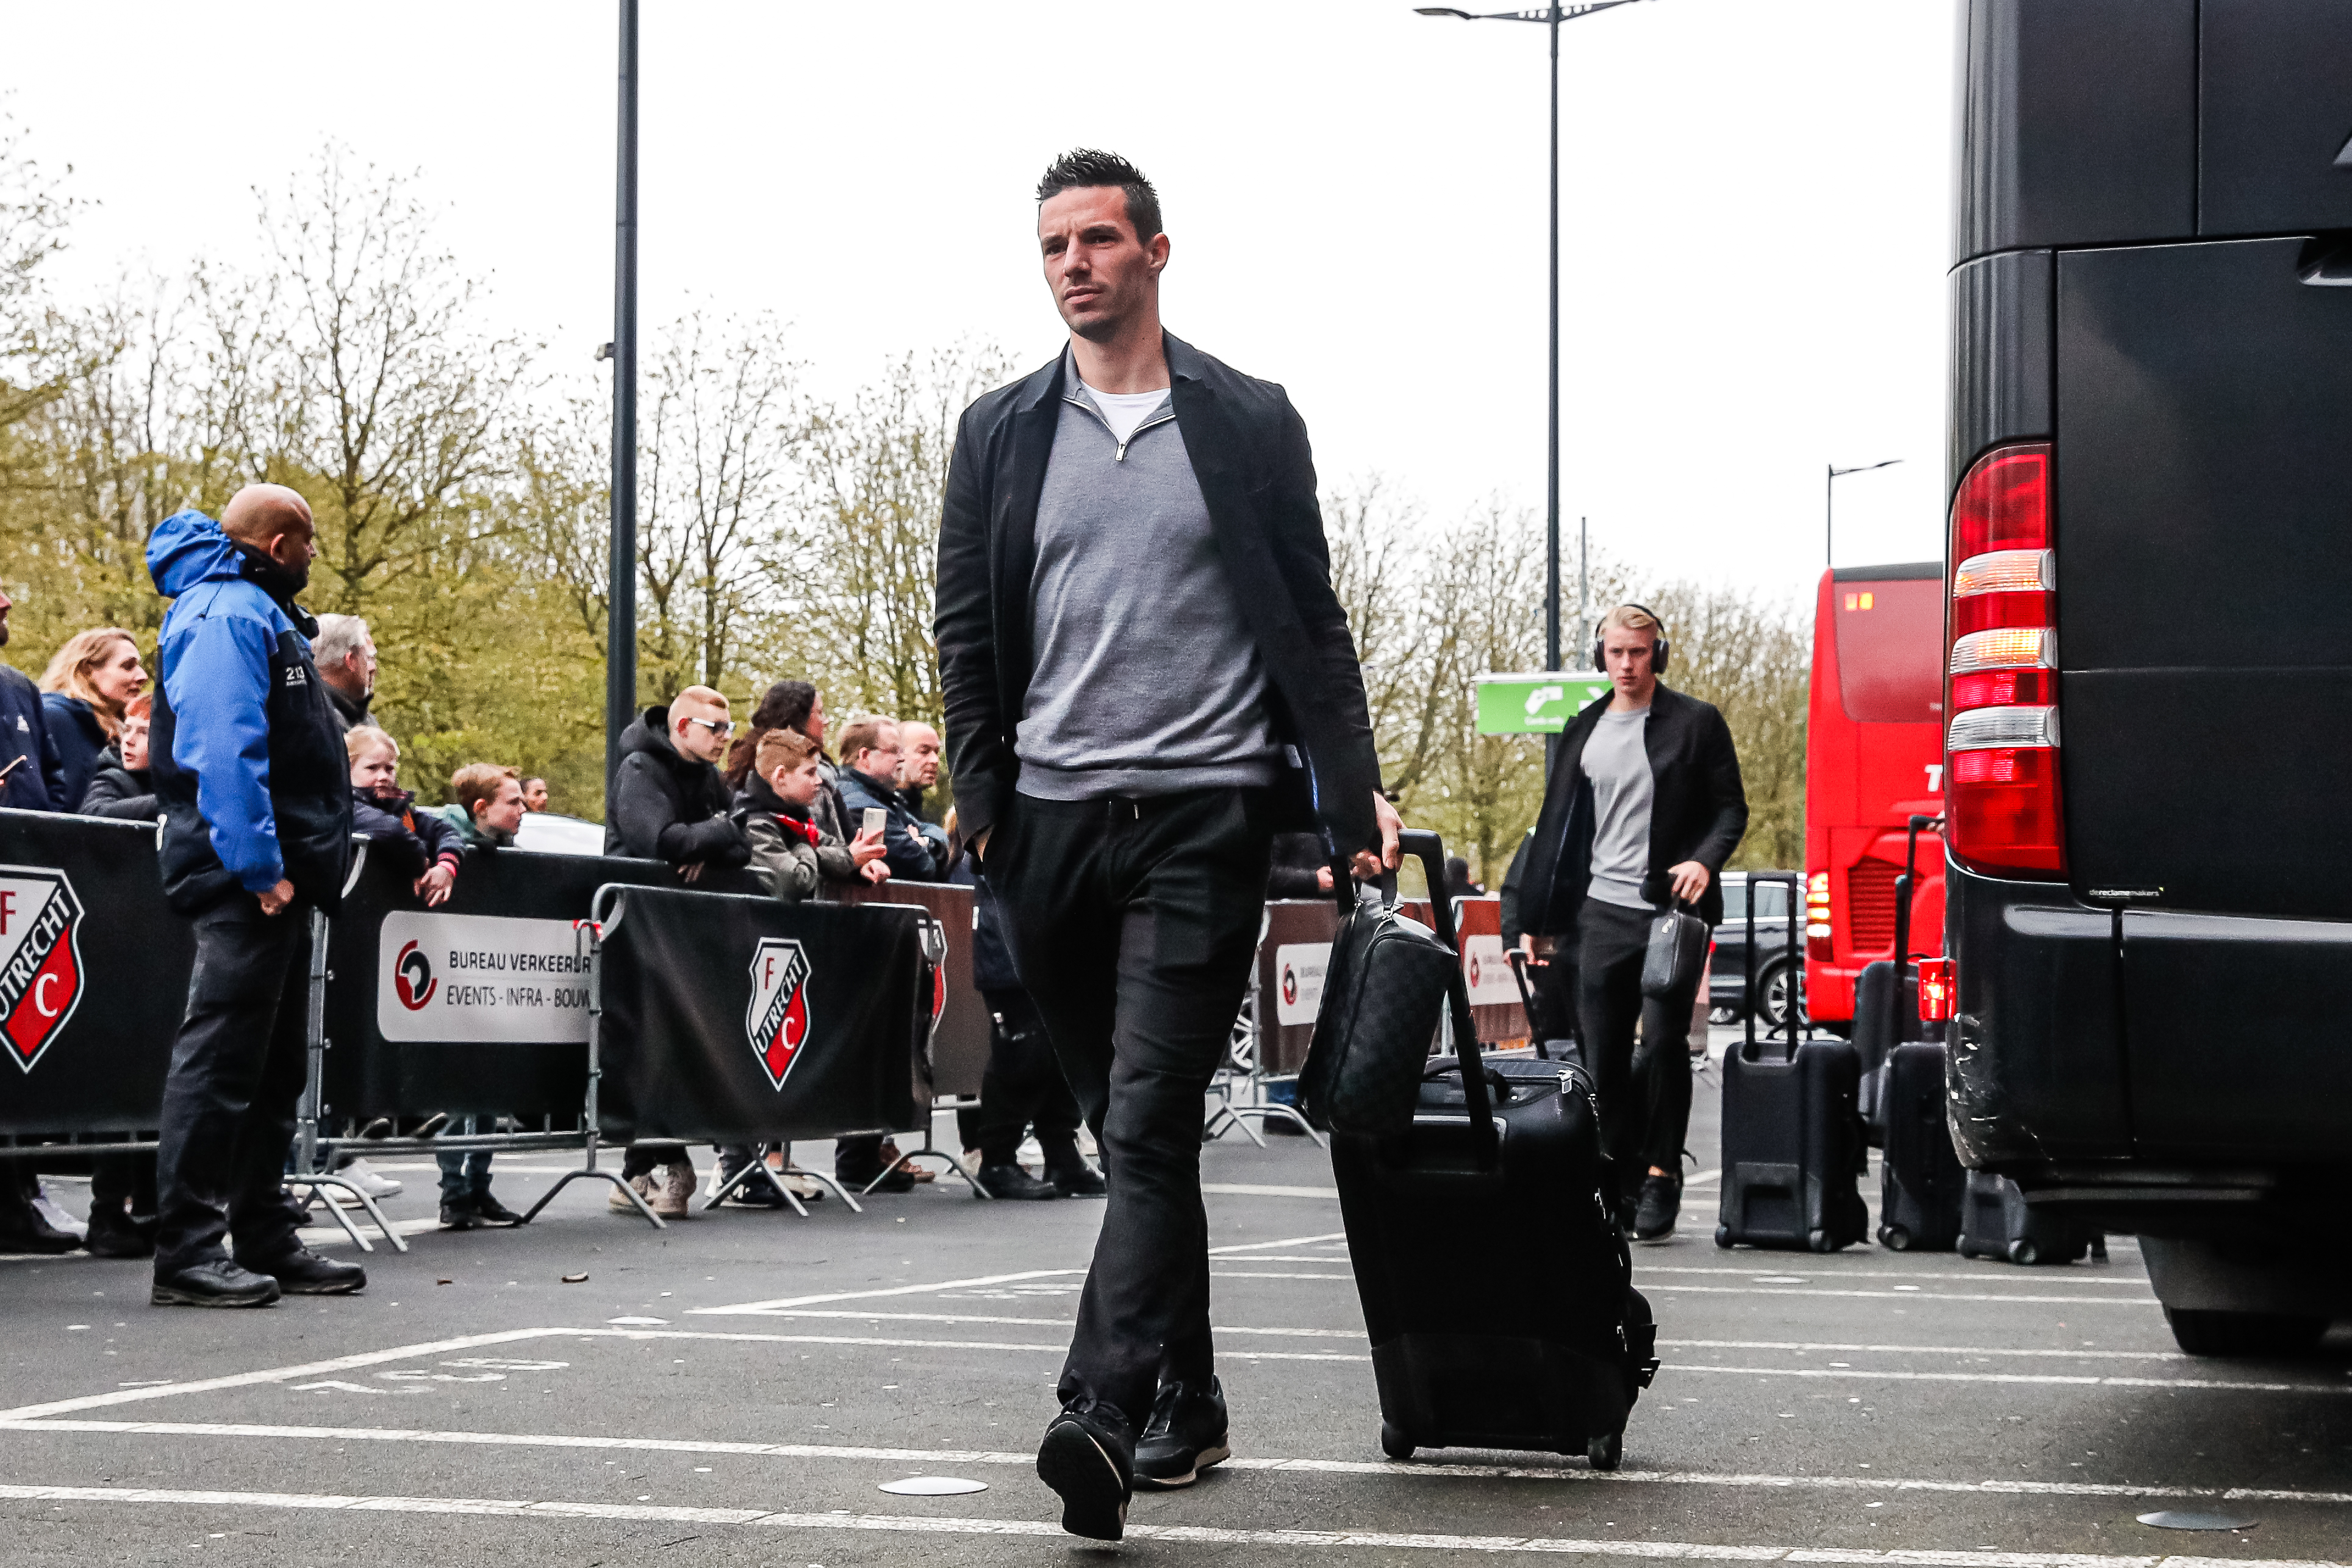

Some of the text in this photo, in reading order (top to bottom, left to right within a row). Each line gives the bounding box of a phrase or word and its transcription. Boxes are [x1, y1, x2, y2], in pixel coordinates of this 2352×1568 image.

[0, 891, 16, 935] F
[450, 951, 506, 970] BUREAU
[764, 957, 775, 990] F
[35, 973, 58, 1017] C
[446, 984, 496, 1006] EVENTS
[507, 987, 543, 1007] INFRA
[756, 954, 802, 1054] UTRECHT
[781, 1017, 795, 1050] C
